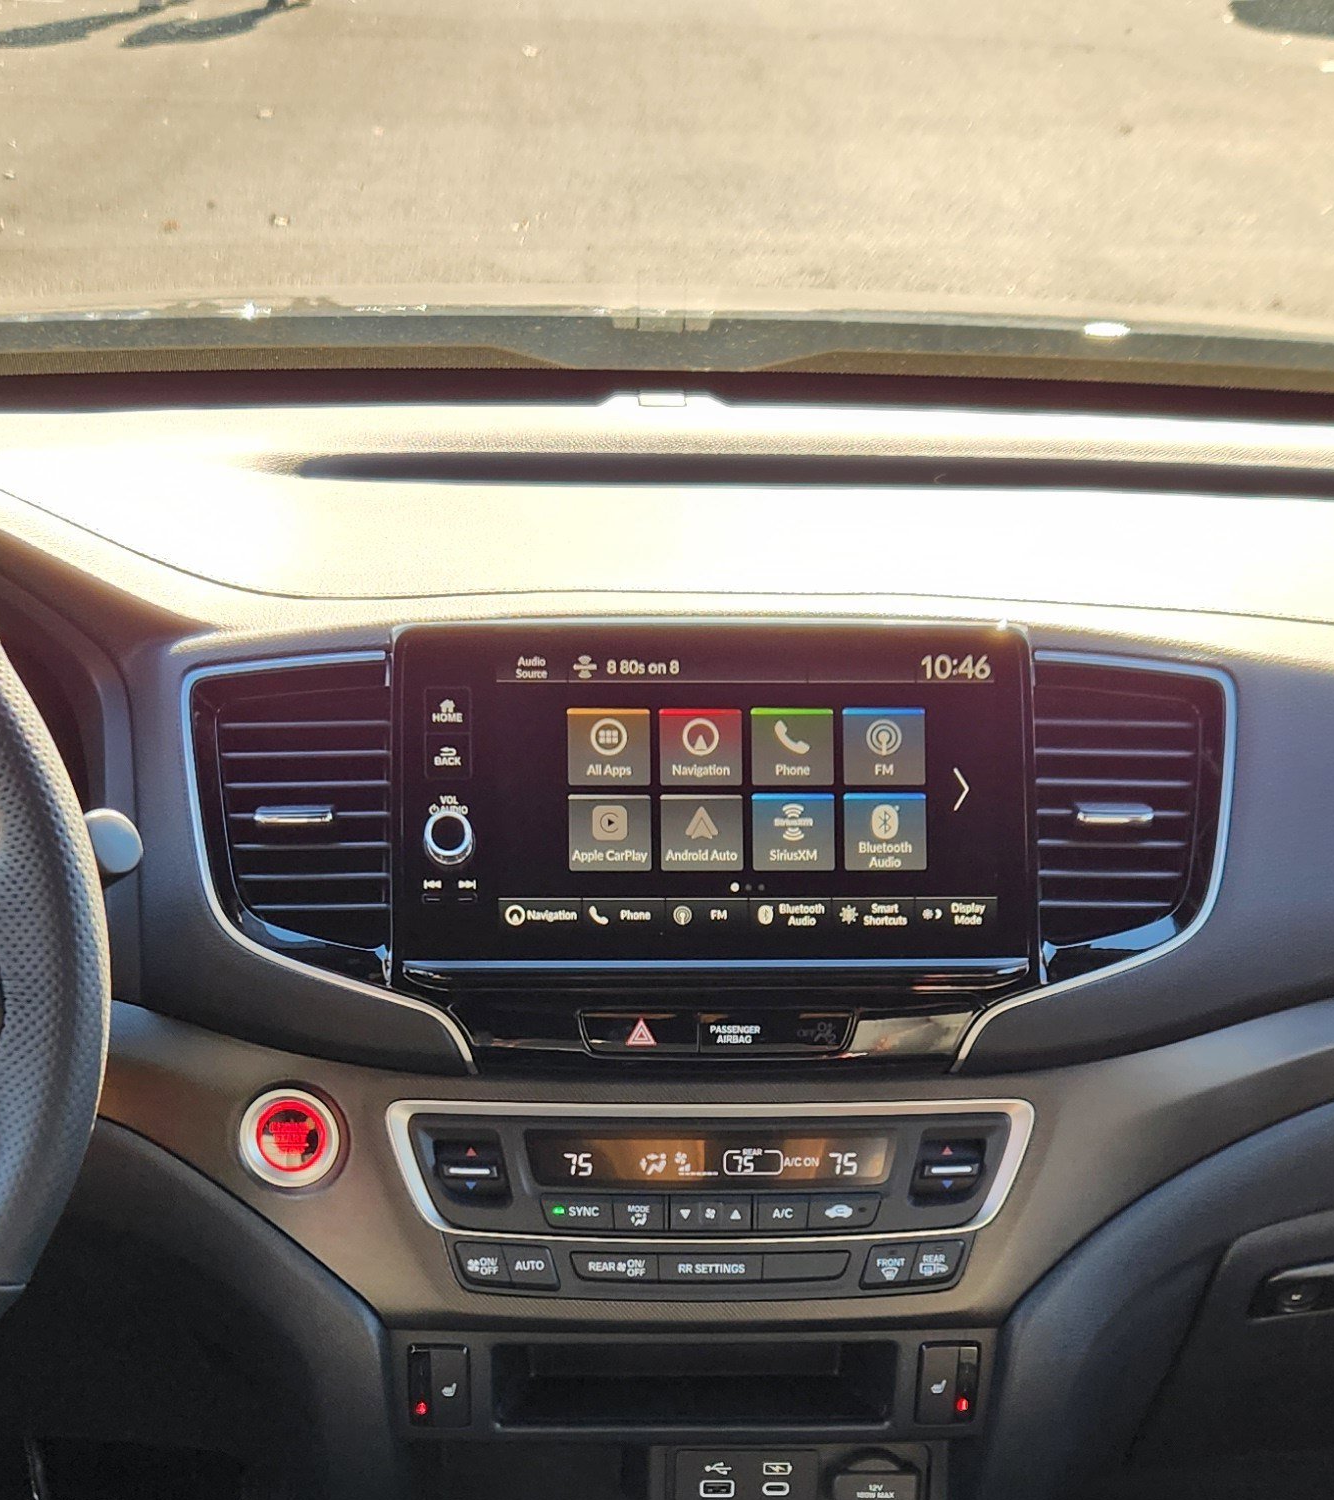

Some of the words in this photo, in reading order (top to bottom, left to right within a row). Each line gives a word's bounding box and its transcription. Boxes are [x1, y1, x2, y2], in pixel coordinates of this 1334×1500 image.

[518, 656, 546, 667] Audio
[607, 660, 616, 674] 8
[620, 660, 645, 674] 80s
[648, 662, 666, 674] on
[669, 660, 679, 674] 8
[921, 654, 991, 679] 10:46
[515, 668, 548, 679] Source
[432, 712, 463, 723] HOME
[434, 756, 462, 766] BACK
[587, 764, 603, 776] All
[604, 764, 632, 778] Apps
[672, 764, 730, 778] Navigation
[775, 764, 810, 776] Phone
[875, 764, 894, 776] FM
[439, 795, 459, 804] VOL
[859, 842, 912, 854] Bluetooth
[572, 849, 604, 862] Apple
[606, 849, 648, 863] CarPlay
[665, 849, 708, 862] Android
[710, 849, 737, 862] Auto
[769, 849, 817, 861] SiriusXM
[869, 856, 901, 868] Audio
[779, 903, 825, 914] Bluetooth
[871, 903, 899, 914] Smart
[951, 902, 986, 915] Display
[527, 909, 577, 922] Navigation
[620, 909, 651, 920] Phone
[710, 910, 728, 920] FM
[863, 914, 908, 926] Shortcuts
[954, 914, 983, 925] Mode
[788, 915, 816, 926] Audio
[709, 1025, 761, 1034] PASSENGER
[716, 1034, 753, 1044] AIRBAG
[742, 1148, 763, 1156] REAR
[564, 1153, 593, 1176] 75
[733, 1155, 755, 1173] 75
[783, 1156, 802, 1168] A/C
[803, 1156, 820, 1168] ON
[829, 1153, 858, 1176] 75
[568, 1205, 600, 1218] SYNC
[627, 1205, 651, 1214] MODE
[772, 1207, 794, 1219] A/C
[480, 1257, 498, 1266] ON/
[627, 1259, 646, 1268] ON/
[876, 1257, 905, 1267] FRONT
[922, 1254, 946, 1263] REAR
[480, 1265, 499, 1275] OFF
[515, 1260, 545, 1271] AUTO
[588, 1261, 615, 1272] REAR
[678, 1263, 694, 1274] RR
[694, 1263, 746, 1274] SETTINGS
[627, 1267, 646, 1277] OFF
